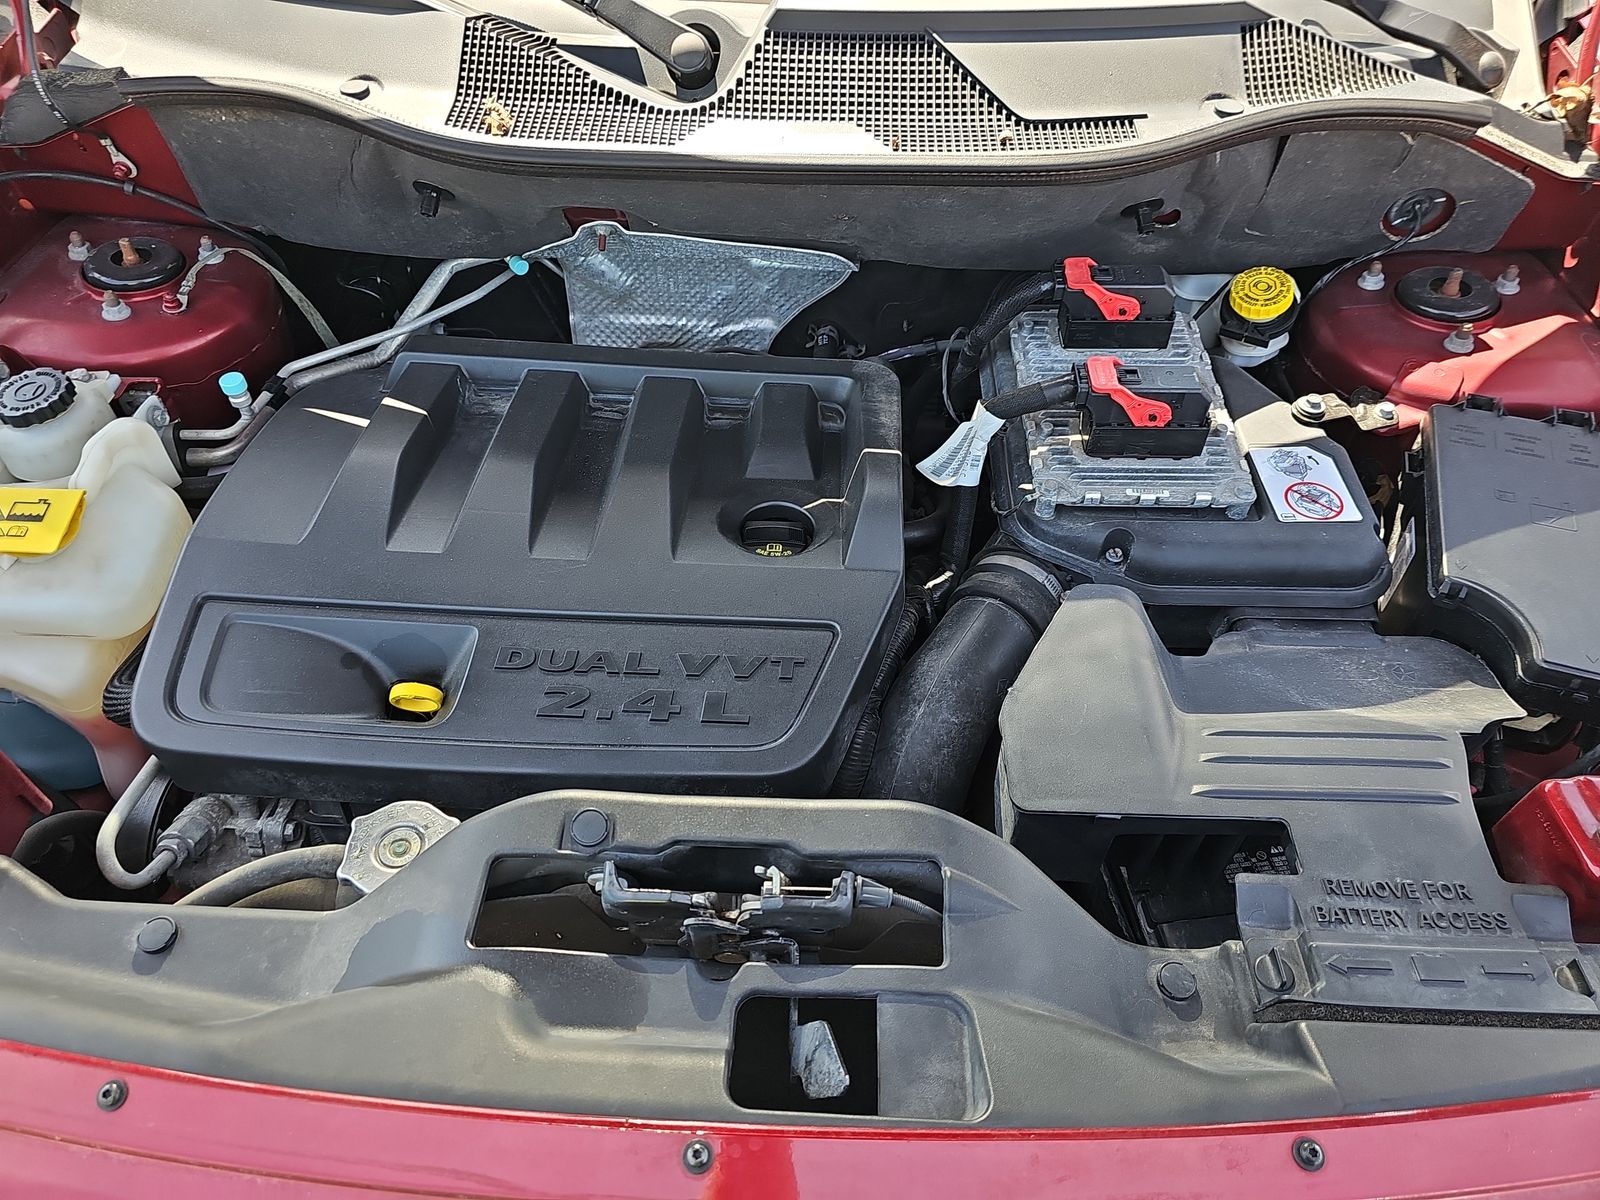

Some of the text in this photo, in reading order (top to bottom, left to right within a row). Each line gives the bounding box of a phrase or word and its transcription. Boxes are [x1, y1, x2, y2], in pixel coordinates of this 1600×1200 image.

[755, 548, 769, 556] SAE
[493, 646, 805, 680] DUAL VVT
[1322, 877, 1474, 901] REMOVE FOR
[1312, 904, 1511, 931] BATTERY ACCESS
